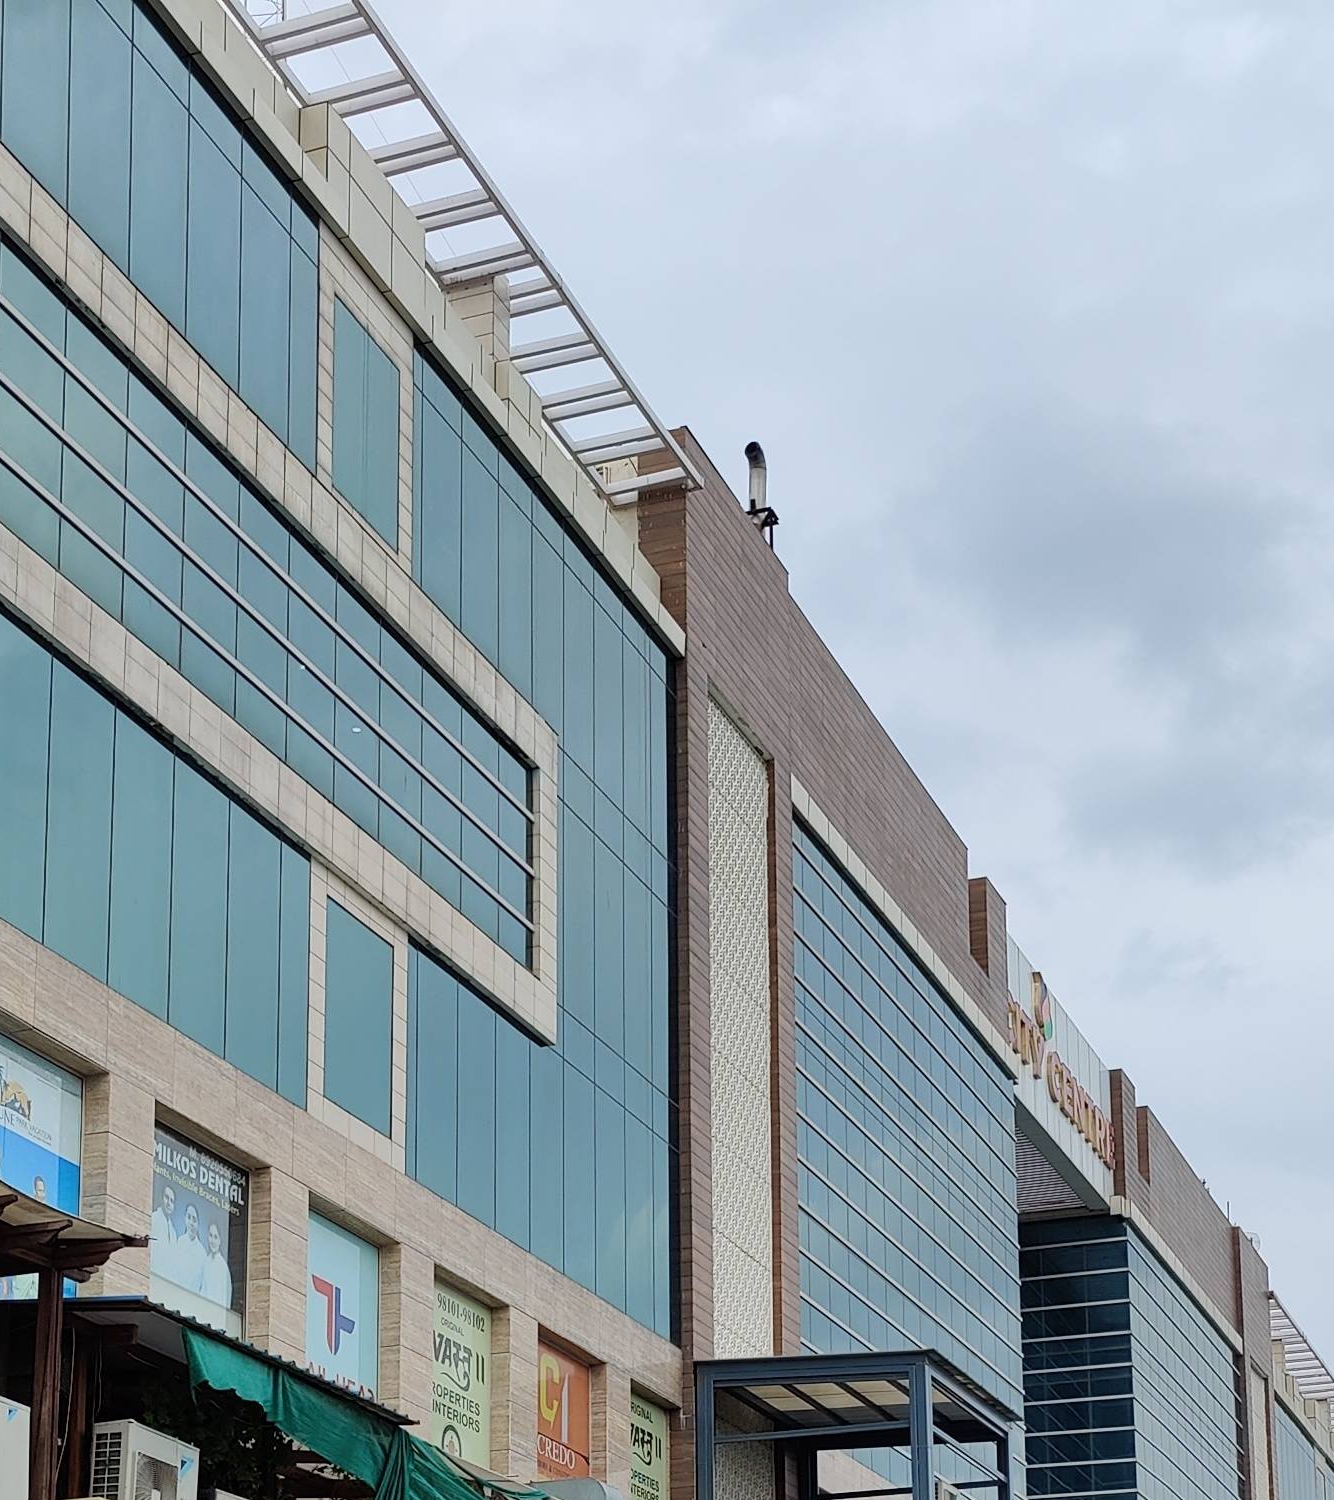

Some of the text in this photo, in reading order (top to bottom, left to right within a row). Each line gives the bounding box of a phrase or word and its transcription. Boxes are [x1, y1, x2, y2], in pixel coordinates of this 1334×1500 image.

[1008, 992, 1046, 1080] ITY
[199, 1166, 245, 1206] DENTAL
[437, 1292, 486, 1333] 98101-98102
[440, 1317, 465, 1337] ORIGINAL
[432, 1402, 481, 1433] INTERIORS
[537, 1435, 576, 1470] CREDO
